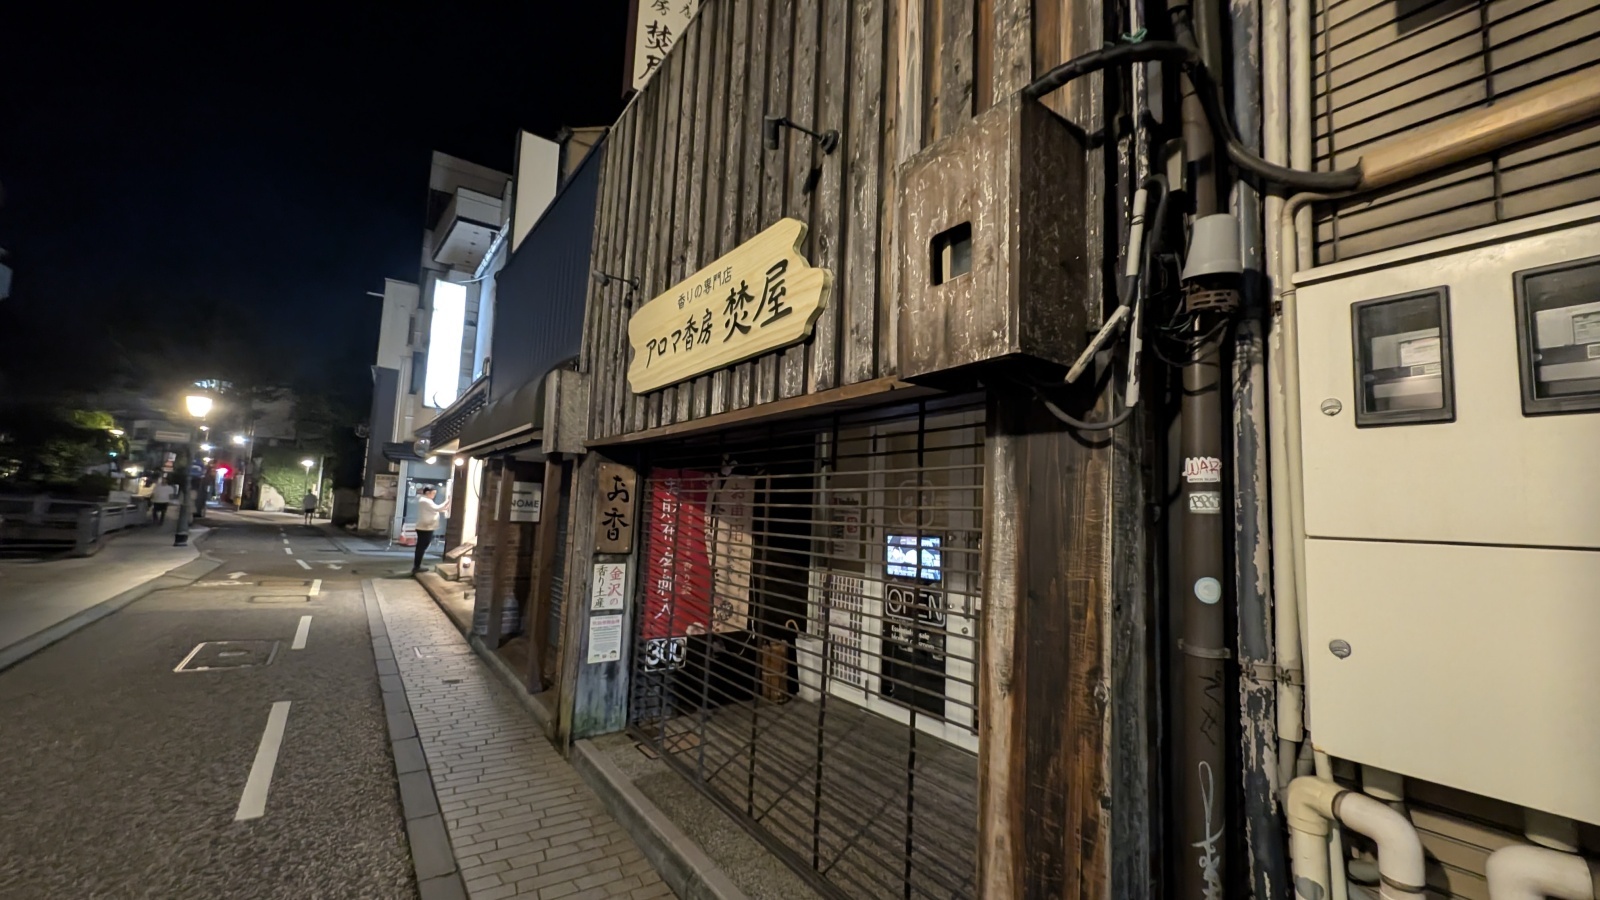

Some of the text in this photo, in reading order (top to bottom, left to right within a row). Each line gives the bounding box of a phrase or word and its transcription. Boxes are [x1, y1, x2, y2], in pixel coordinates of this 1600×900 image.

[677, 266, 734, 310] 香りの専門店
[645, 257, 793, 369] アロマ香房 焚屋
[601, 474, 631, 542] お香
[593, 564, 608, 609] 香り土産
[607, 565, 624, 606] 金沢の
[887, 588, 942, 622] OPEN
